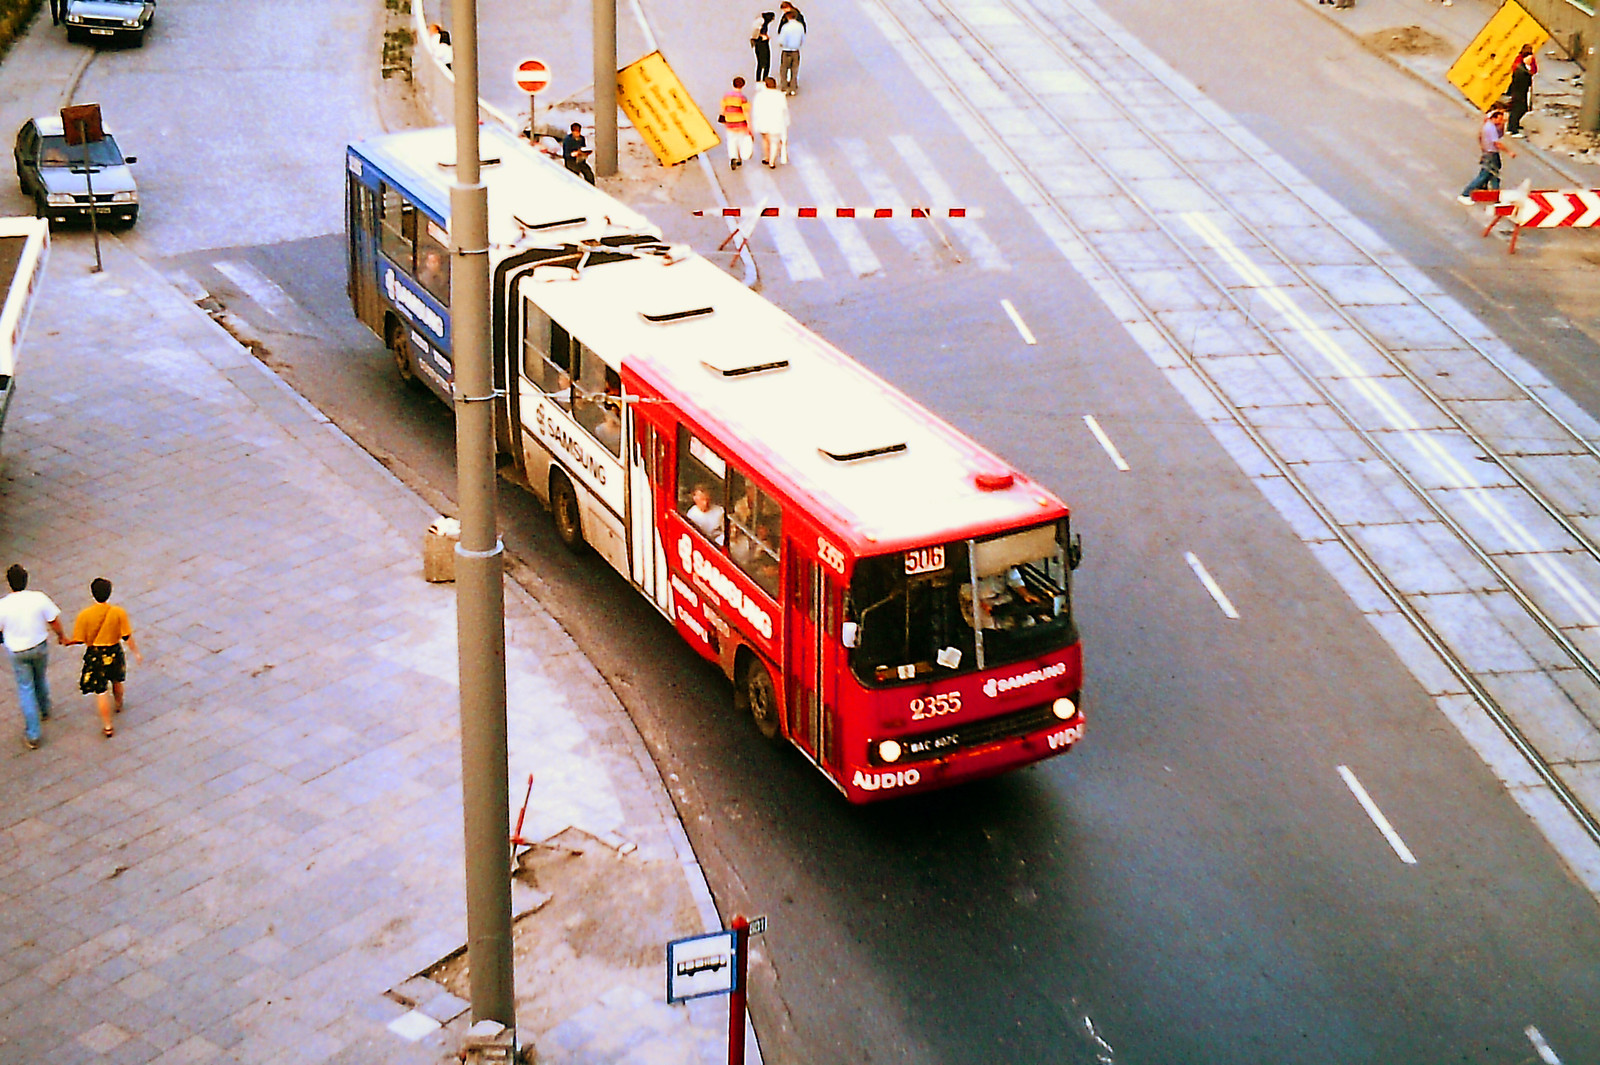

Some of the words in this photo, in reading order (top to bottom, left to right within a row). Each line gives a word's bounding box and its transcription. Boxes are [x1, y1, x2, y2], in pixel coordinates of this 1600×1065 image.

[547, 416, 607, 486] SAMSUNG
[692, 550, 773, 639] SAMSUNG
[997, 662, 1067, 692] SAMSUNG
[909, 691, 963, 721] 2355
[853, 769, 921, 791] AUDIO
